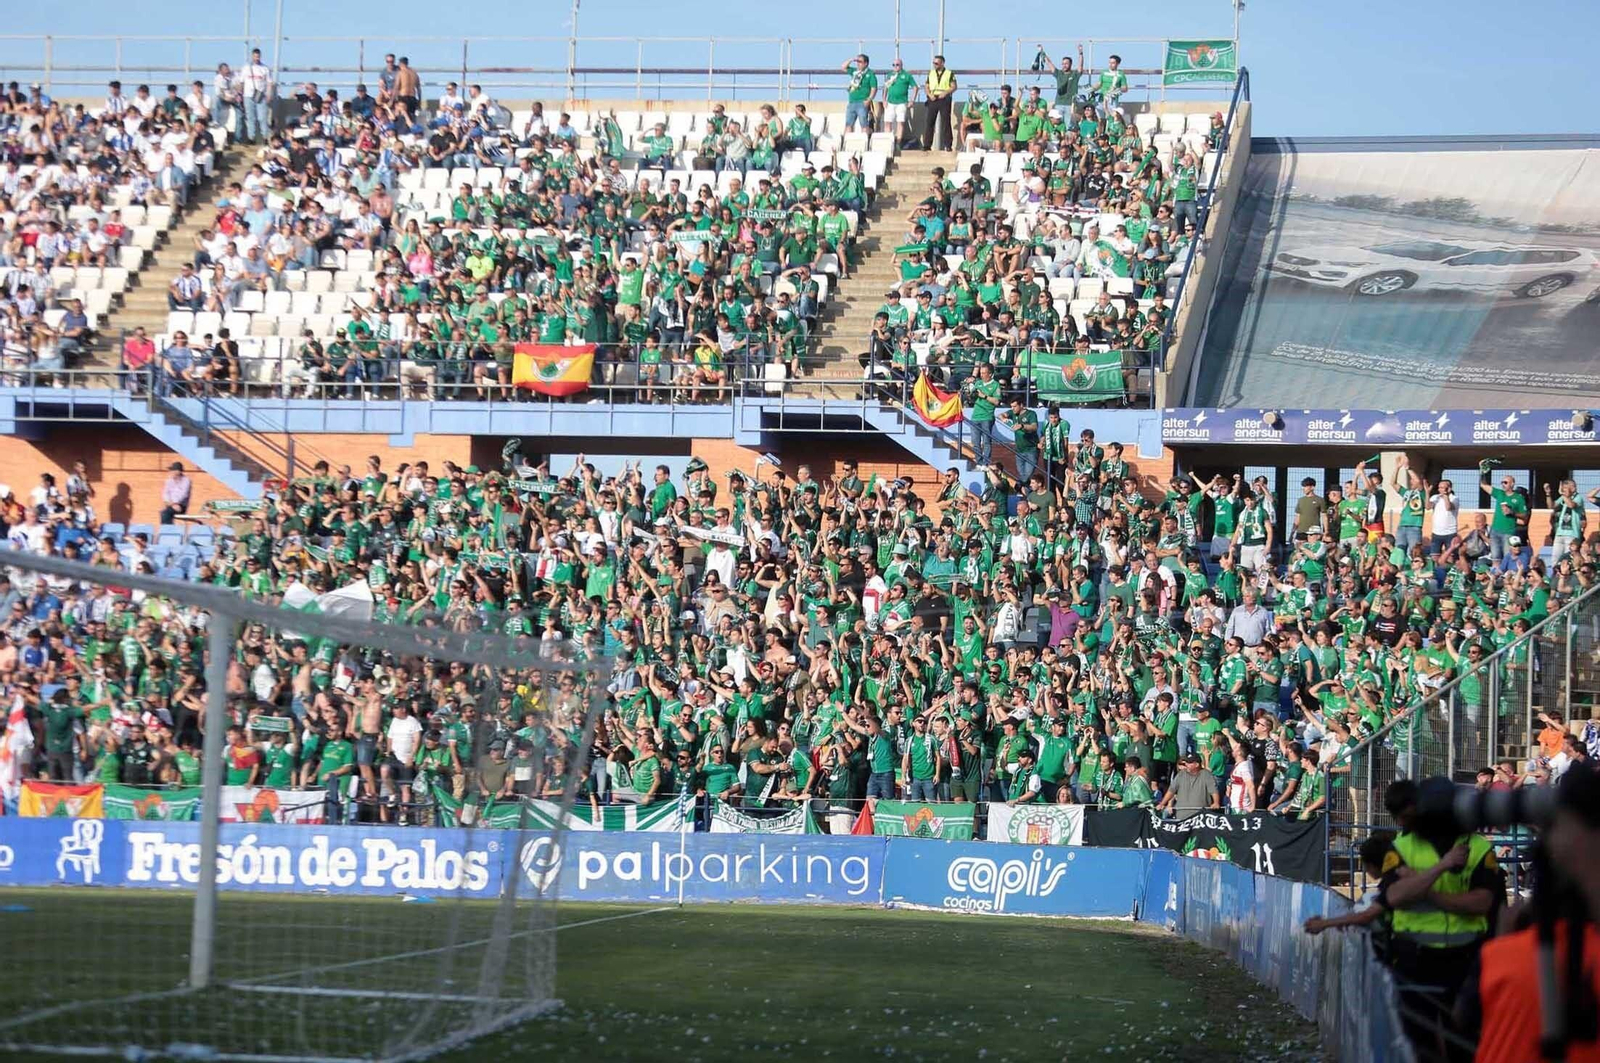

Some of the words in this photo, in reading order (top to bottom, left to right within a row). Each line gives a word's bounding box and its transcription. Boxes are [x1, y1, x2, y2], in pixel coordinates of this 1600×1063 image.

[1041, 371, 1058, 390] 19
[1100, 370, 1119, 389] 19
[1162, 418, 1190, 429] alter
[1234, 418, 1262, 429] alter
[1307, 419, 1336, 430] alter
[1405, 420, 1433, 431] alter
[1473, 420, 1501, 430] alter
[1162, 428, 1210, 438] enersun
[1234, 428, 1282, 438] enersun
[1307, 430, 1356, 439] enersun
[1405, 430, 1452, 440] enersun
[1473, 430, 1521, 440] enersun
[1547, 430, 1596, 440] enersun
[1241, 817, 1262, 831] 13
[126, 832, 295, 885] Fresón
[298, 835, 358, 887] de
[360, 838, 490, 891] Palos
[578, 841, 869, 895] palparking
[947, 848, 1068, 911] capi's
[943, 895, 993, 911] cocinas
